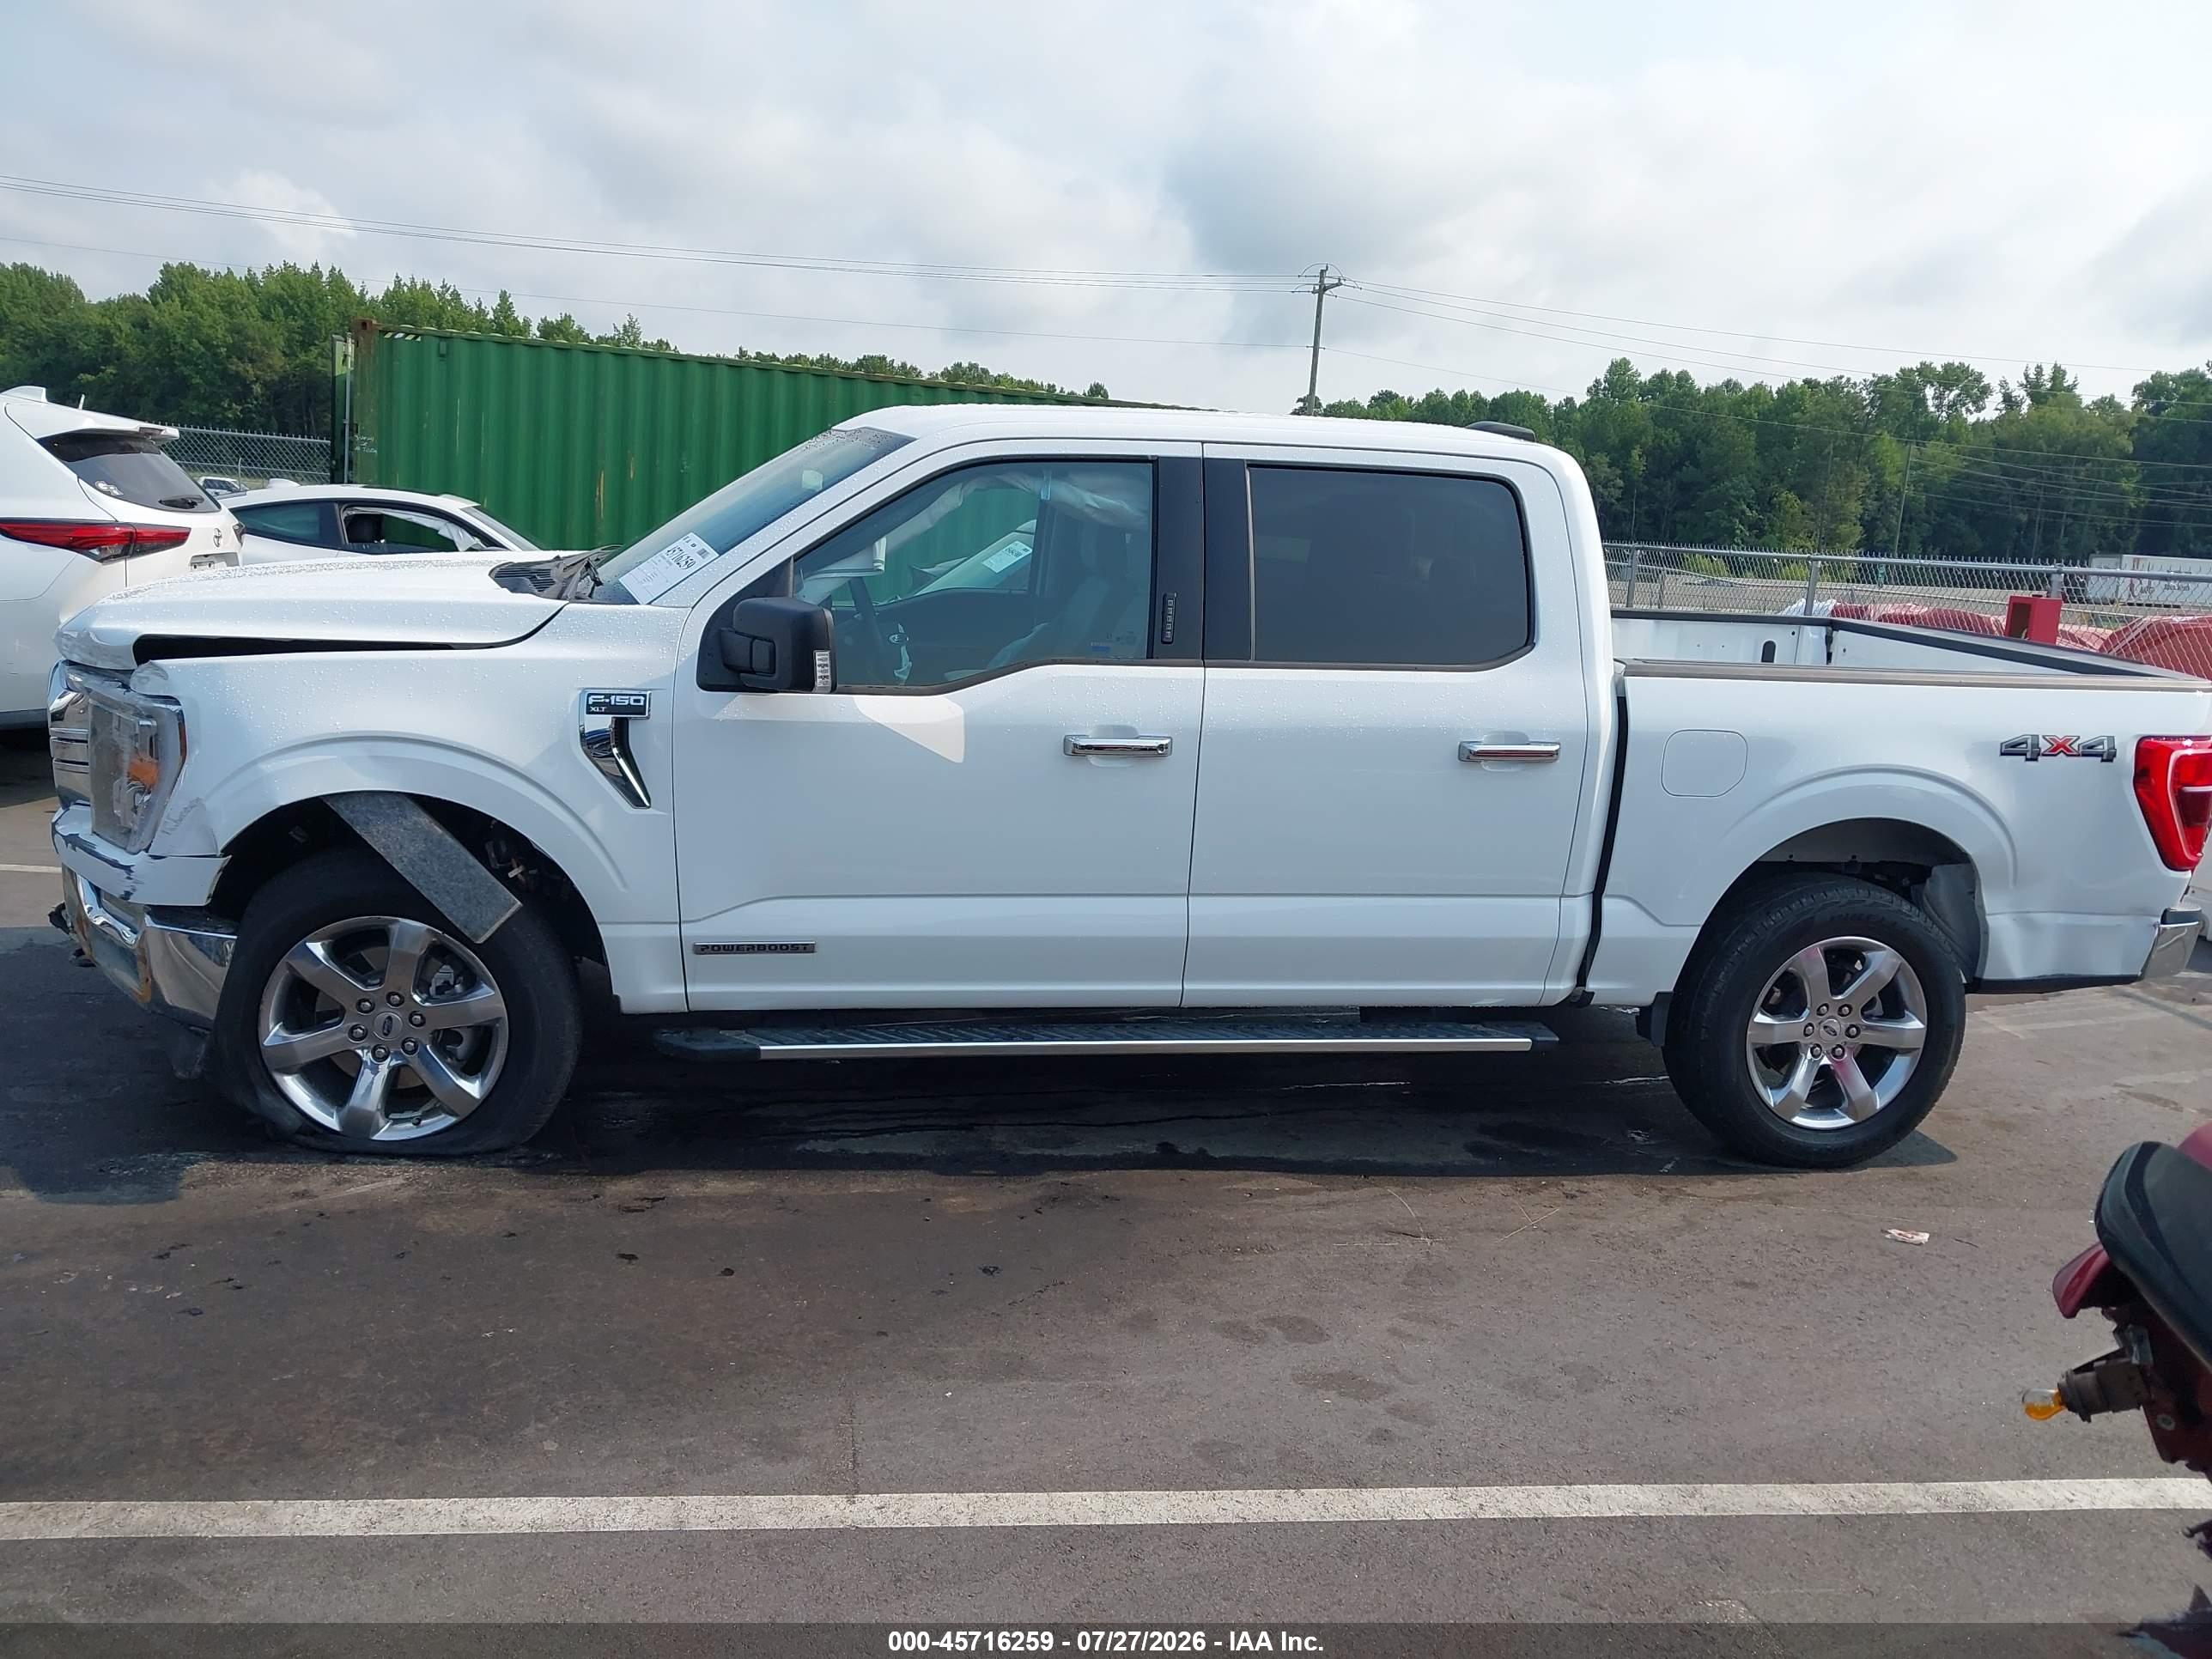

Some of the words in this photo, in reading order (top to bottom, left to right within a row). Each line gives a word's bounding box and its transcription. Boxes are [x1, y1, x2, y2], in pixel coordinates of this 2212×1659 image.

[665, 545, 696, 570] 45716259
[588, 695, 646, 706] F-150
[699, 944, 811, 953] POWERBOOST
